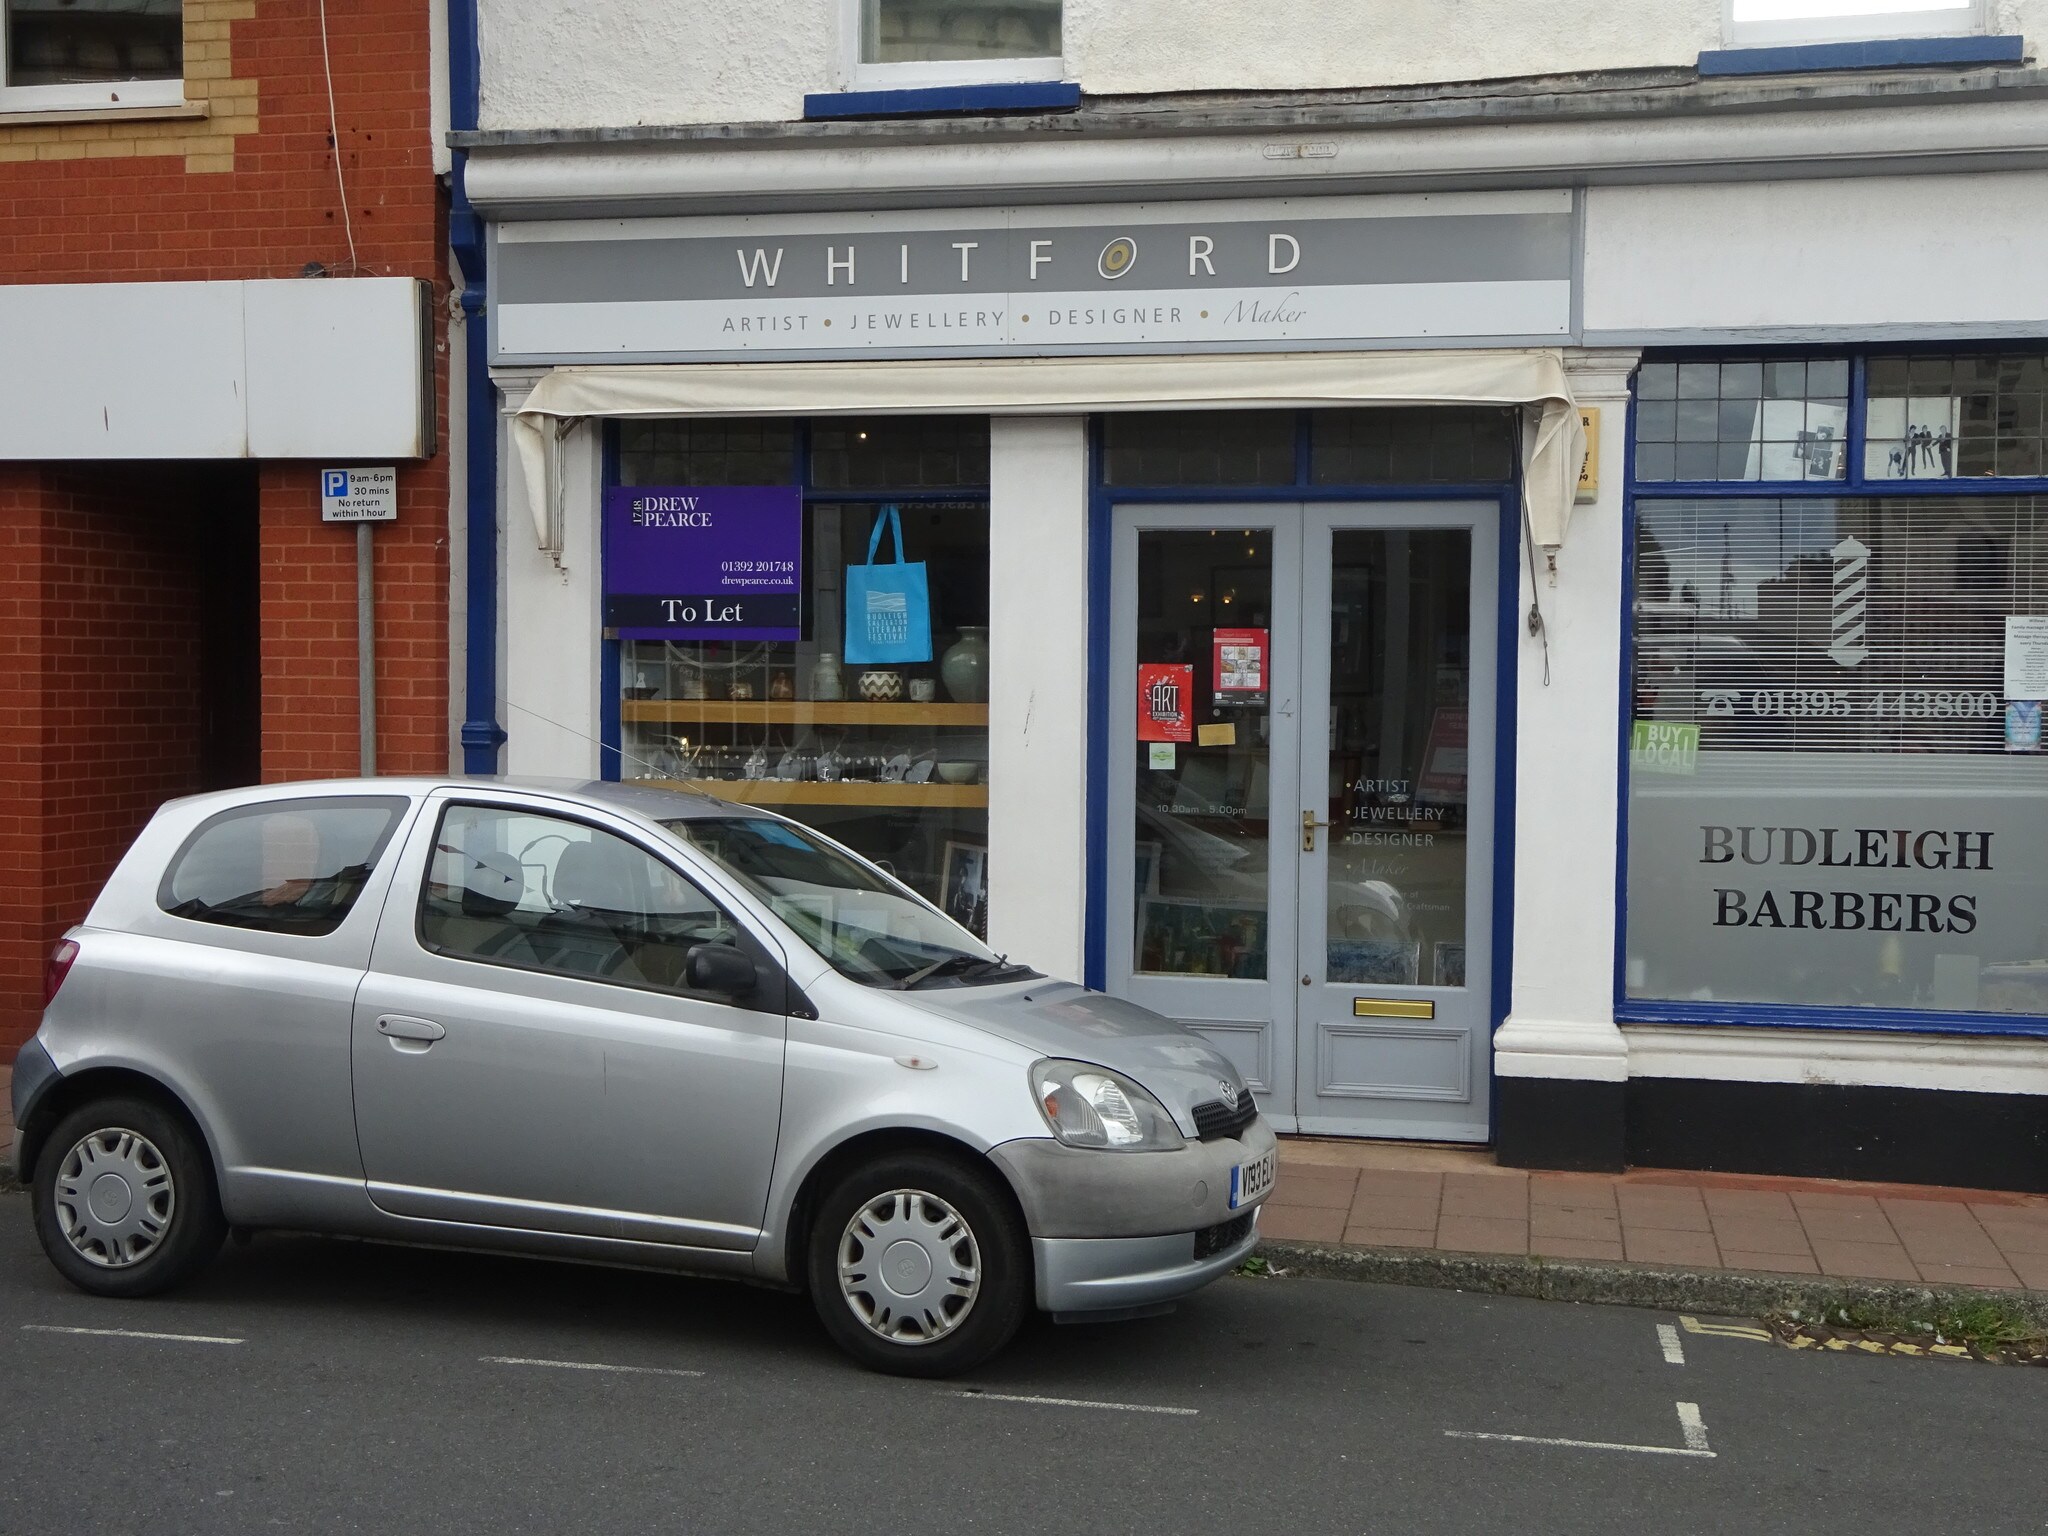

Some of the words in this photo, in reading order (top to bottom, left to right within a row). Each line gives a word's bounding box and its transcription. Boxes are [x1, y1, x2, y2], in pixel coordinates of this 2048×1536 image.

[737, 233, 1301, 288] WHITFORD
[722, 315, 809, 333] ARTIST
[850, 311, 1005, 330] JEWELLERY
[1048, 307, 1182, 326] DESIGNER
[1223, 291, 1307, 326] Maker
[328, 472, 344, 496] P
[354, 487, 367, 495] 30
[369, 486, 390, 495] mins
[332, 510, 359, 518] within
[366, 509, 387, 517] hour
[338, 499, 351, 507] No
[352, 499, 380, 507] return
[633, 500, 642, 523] 1748
[644, 497, 699, 511] DREW
[644, 512, 713, 527] PEARCE
[721, 561, 754, 572] 01392
[755, 561, 794, 572] 201748
[721, 575, 794, 587] drewpearce.co.uk
[661, 598, 698, 623] To
[704, 598, 744, 623] Let
[1152, 685, 1179, 712] ART
[1751, 690, 1851, 717] 01395
[1866, 691, 1998, 718] 443800
[1647, 724, 1683, 743] BUY
[1635, 731, 1692, 767] LOCAL
[1353, 779, 1410, 793] ARTIST
[1352, 805, 1445, 821] JEWELLERY
[1351, 831, 1434, 847] DESIGNER
[1699, 825, 1995, 871] BUDLEIGH
[1712, 888, 1977, 934] BARBERS
[1242, 1160, 1261, 1197] V193
